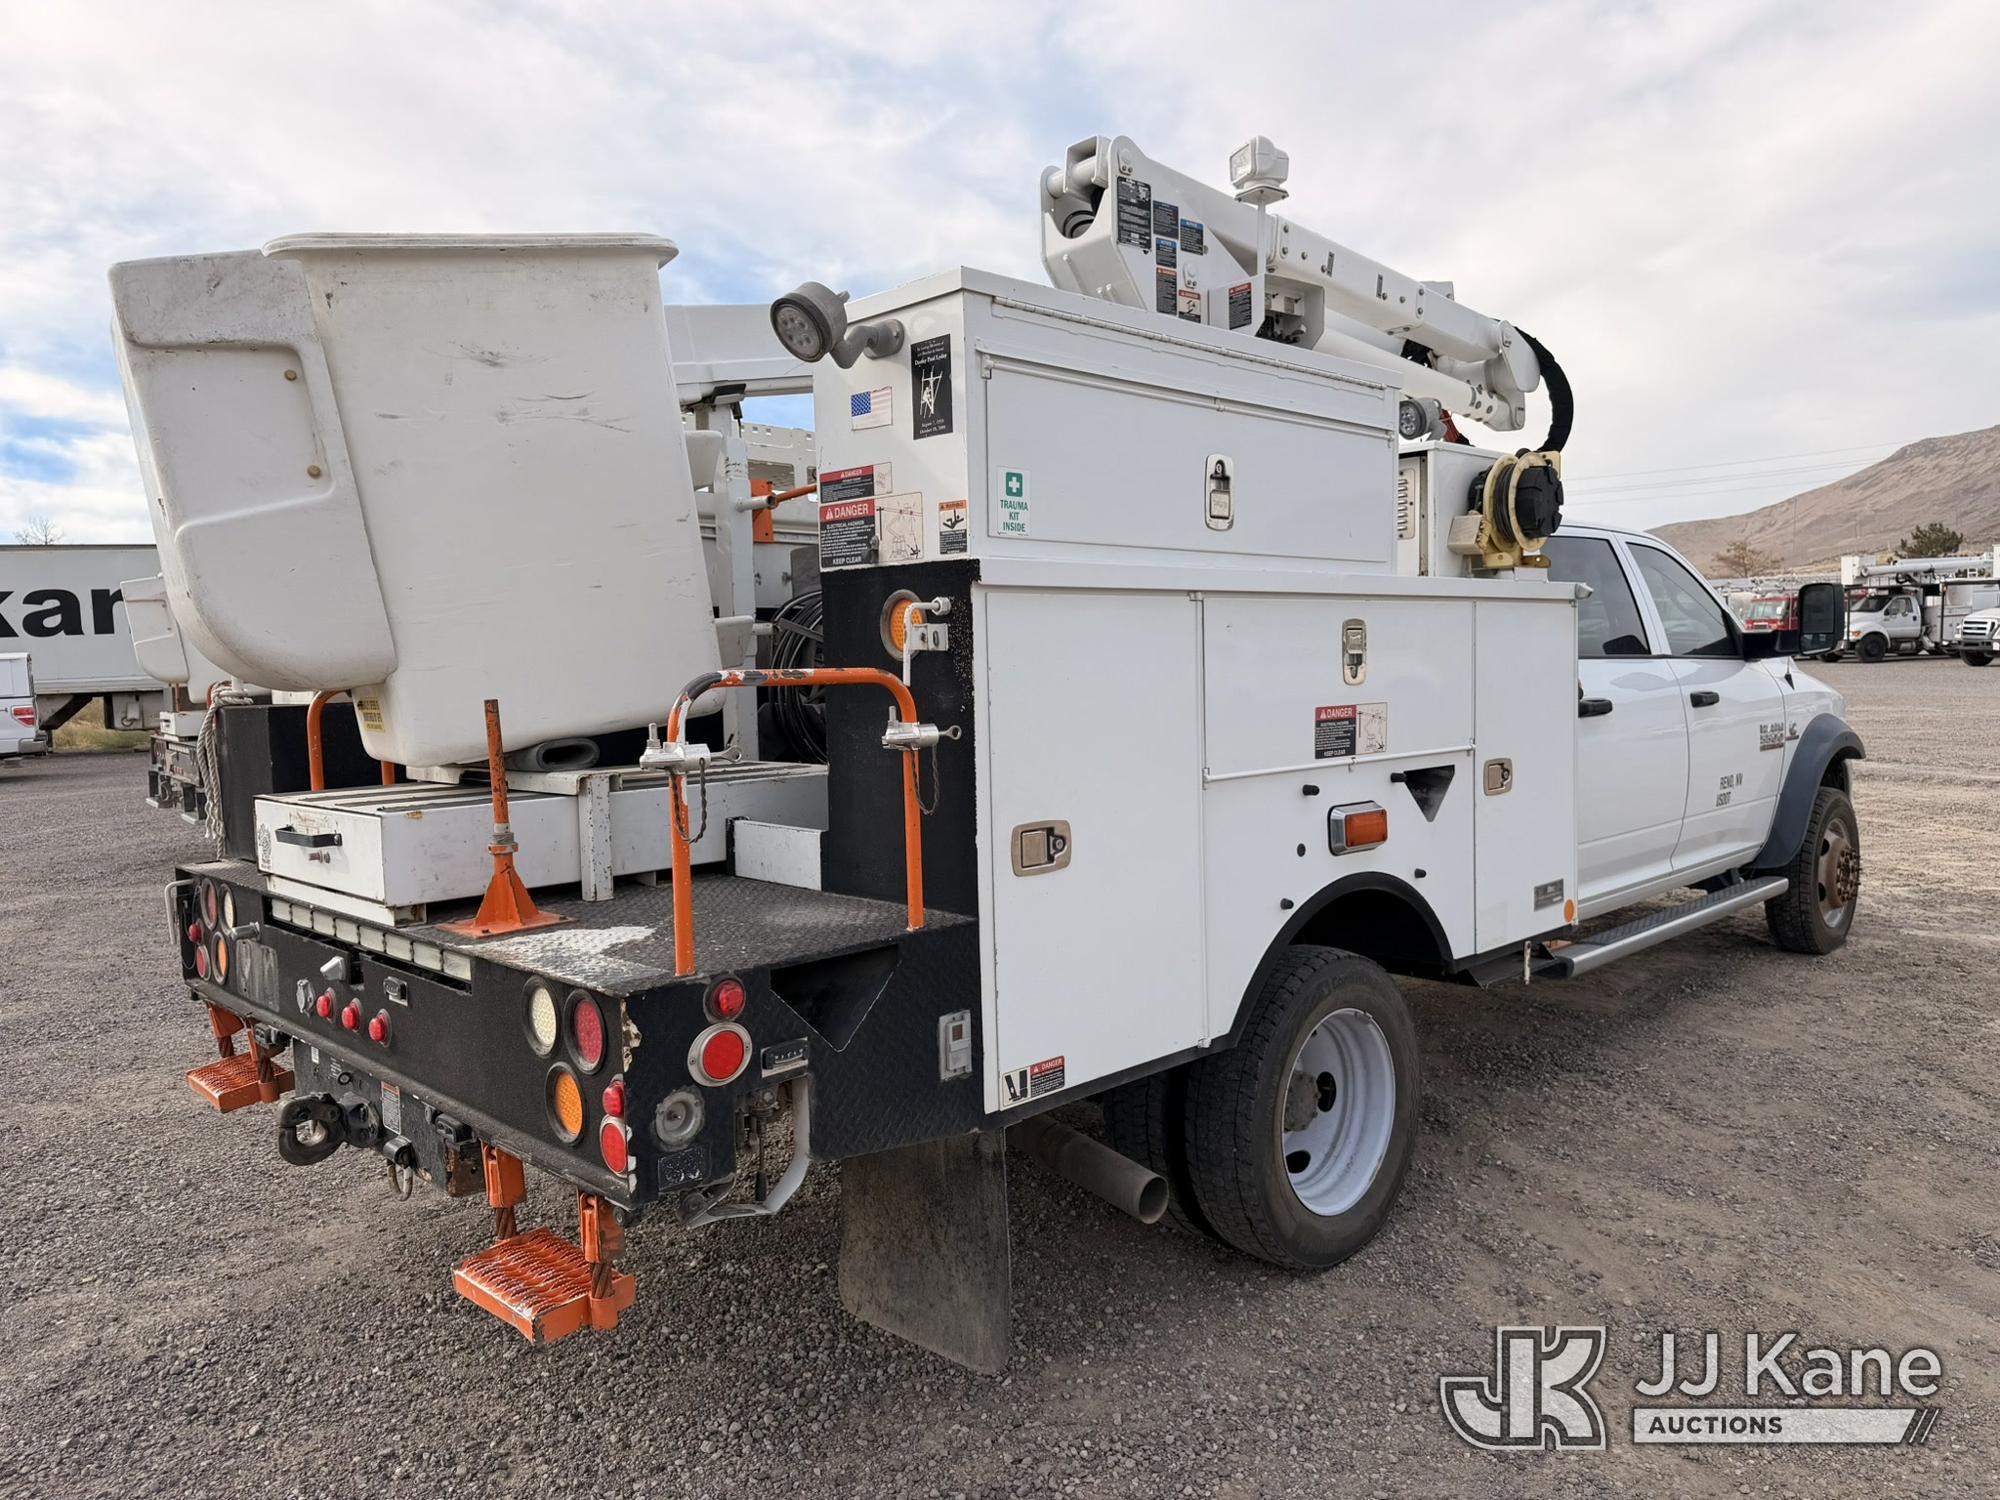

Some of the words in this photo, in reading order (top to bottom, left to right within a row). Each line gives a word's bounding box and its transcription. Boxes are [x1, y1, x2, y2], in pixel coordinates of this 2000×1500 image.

[834, 503, 869, 519] DANGER
[1000, 499, 1028, 511] TRAUMA
[1009, 511, 1020, 521] KIT
[1002, 521, 1026, 533] INSIDE
[832, 557, 846, 565] KEEP
[846, 556, 862, 564] CLEAR
[1326, 707, 1353, 718] DANGER
[1041, 1058, 1063, 1070] DANGER
